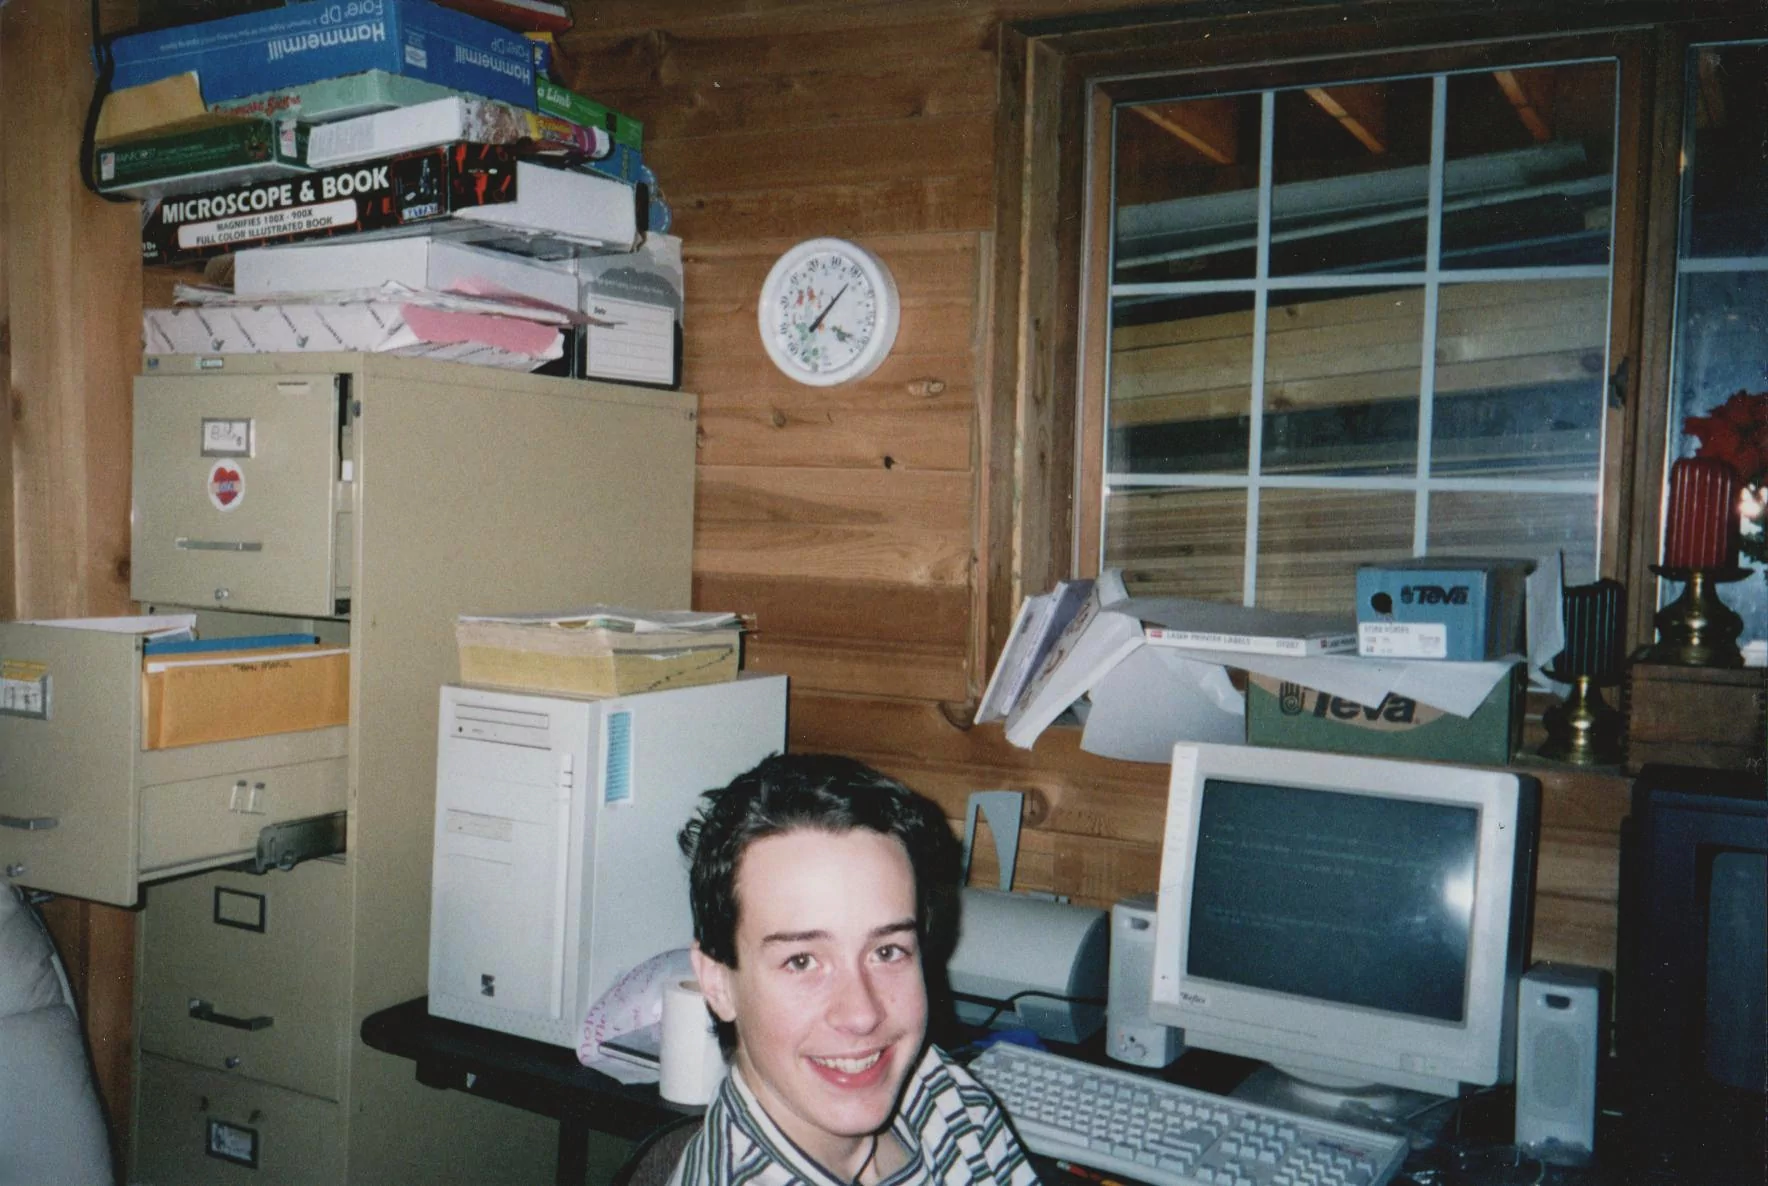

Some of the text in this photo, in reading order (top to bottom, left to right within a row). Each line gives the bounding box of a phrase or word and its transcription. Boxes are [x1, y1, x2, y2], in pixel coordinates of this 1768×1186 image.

[267, 22, 387, 62] Hammermill
[455, 43, 531, 87] Hammermill
[162, 166, 390, 224] MICROSCOPE & BOOK
[196, 215, 333, 245] FULL COLOR ILLUSTRATED BOOK
[216, 217, 262, 231] MAGNIFIES
[264, 213, 285, 225] 100X
[290, 208, 313, 221] 900X
